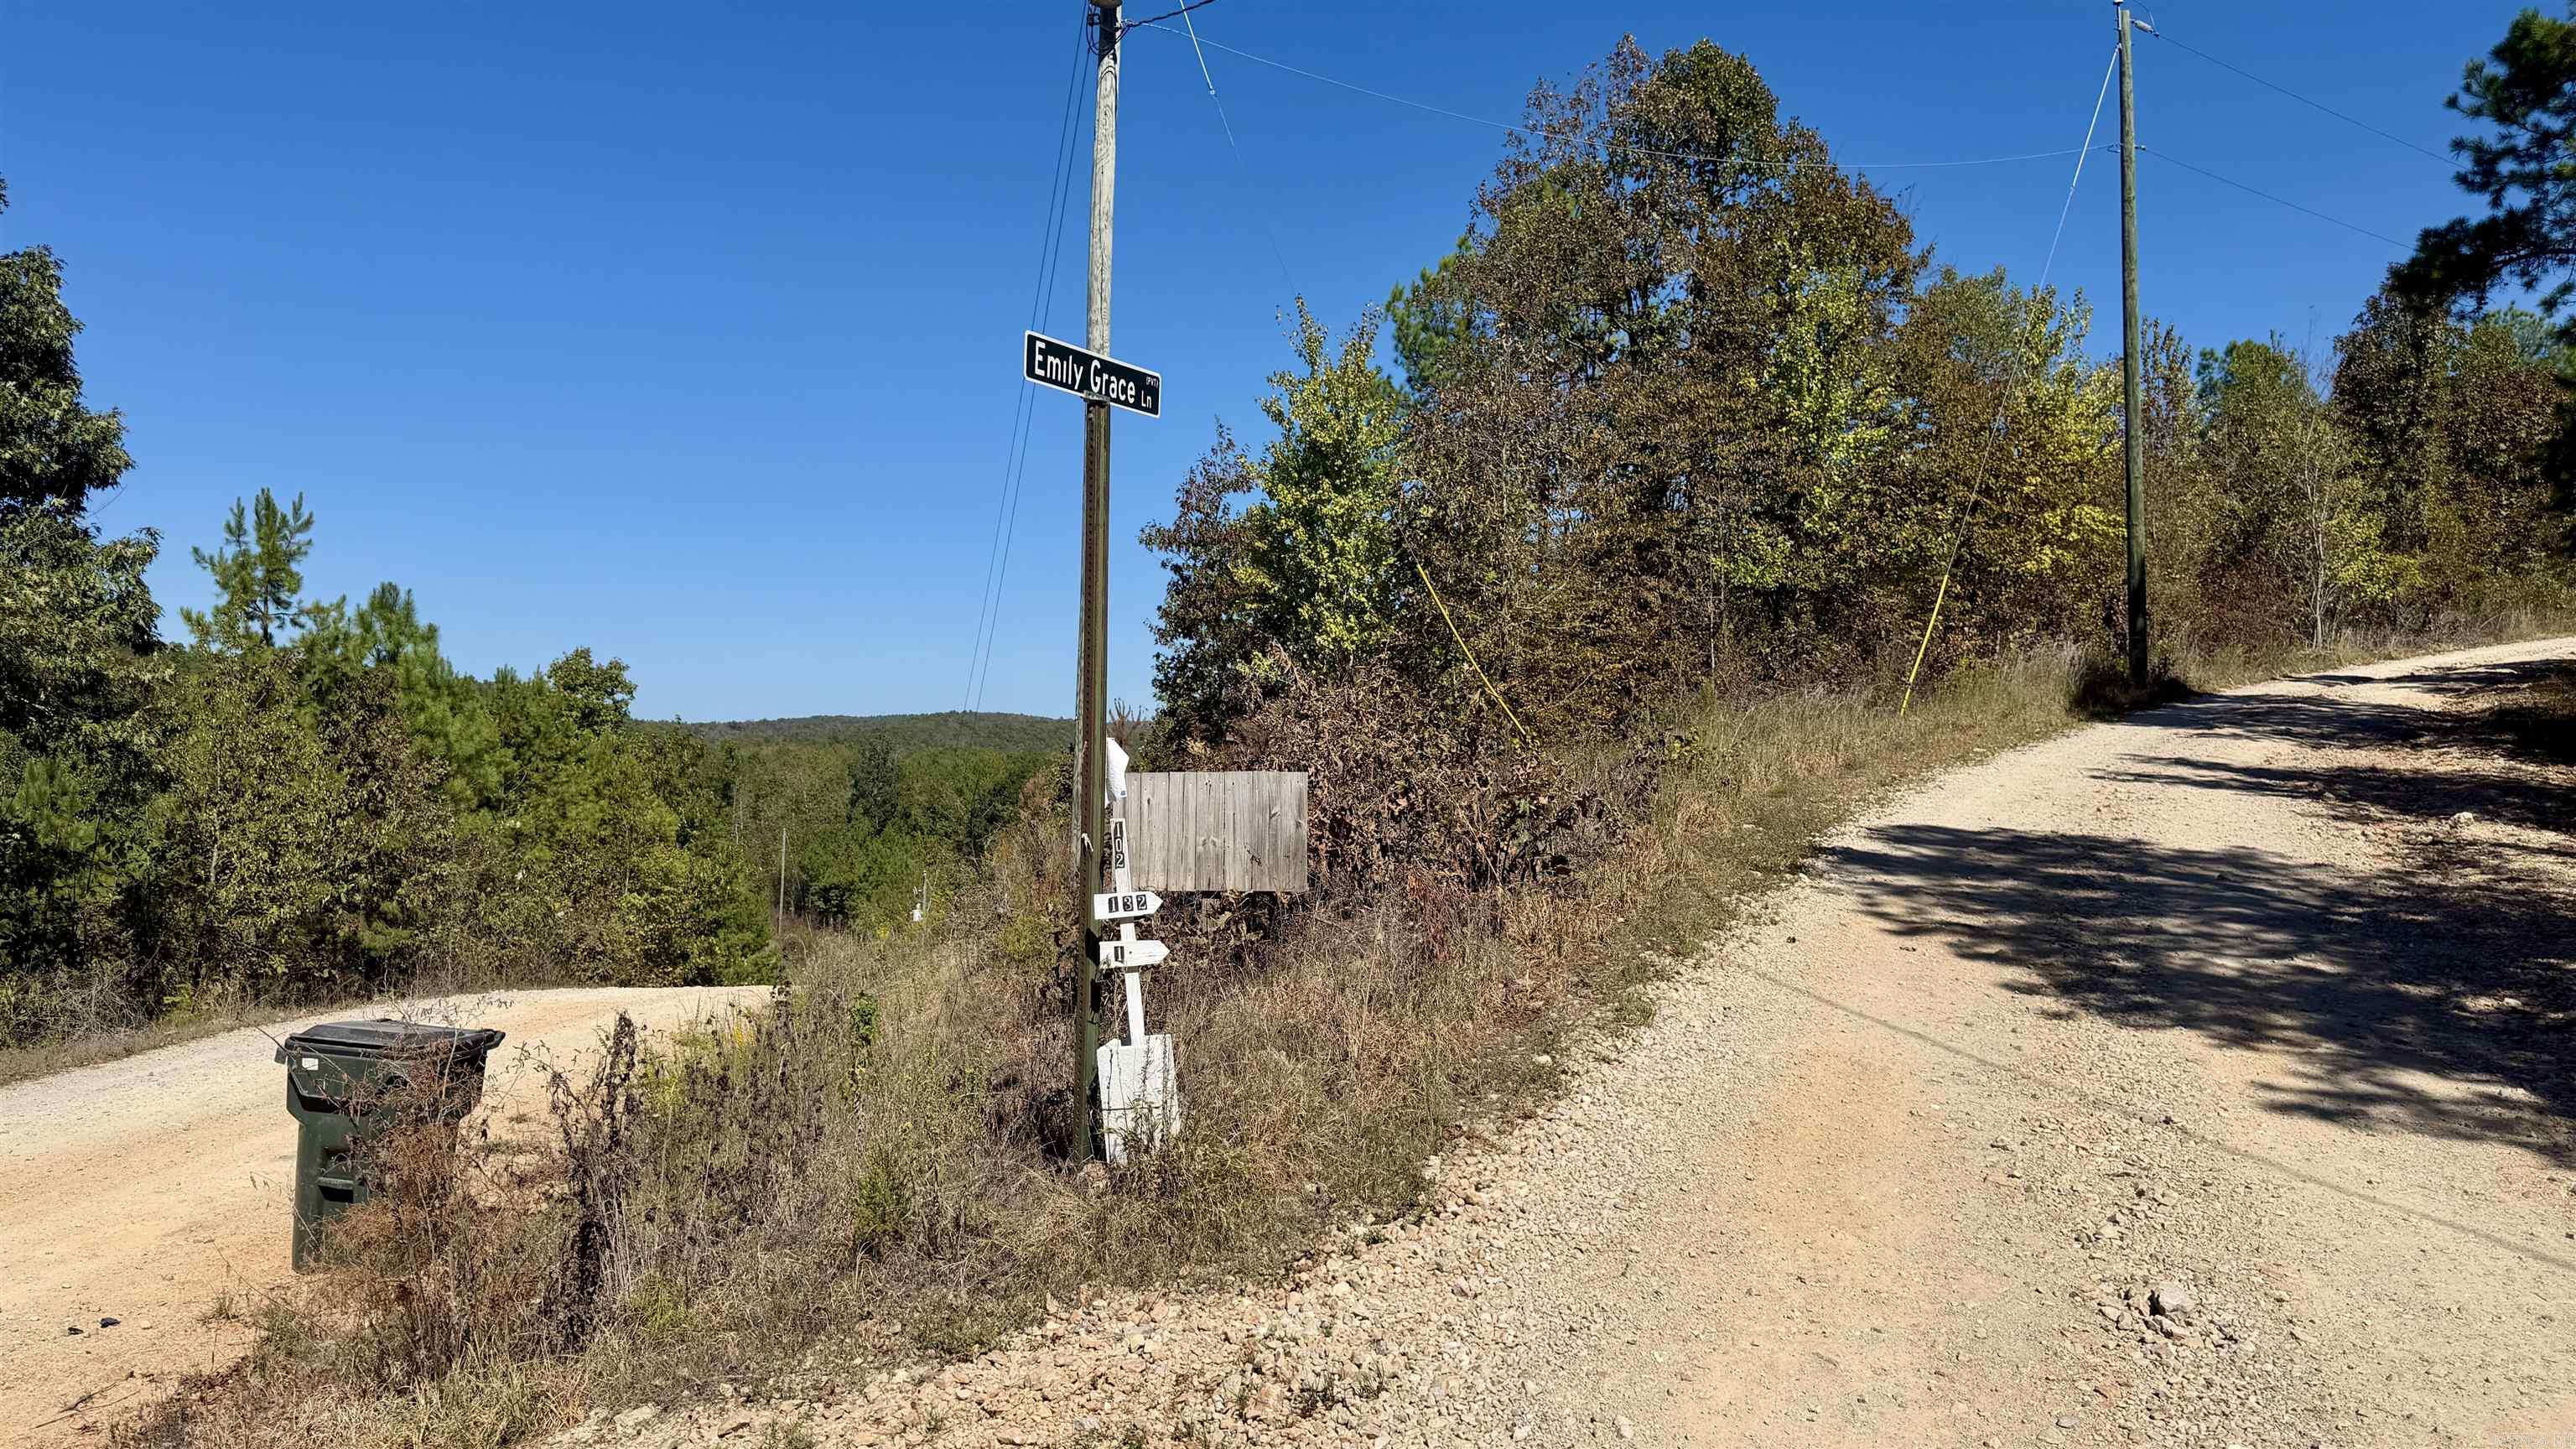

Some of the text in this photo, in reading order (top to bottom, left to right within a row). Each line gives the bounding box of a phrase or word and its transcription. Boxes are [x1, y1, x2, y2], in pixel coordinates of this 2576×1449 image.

[1034, 340, 1152, 409] Emily Grace Ln
[1114, 822, 1124, 868] 102
[1109, 895, 1147, 912] 132
